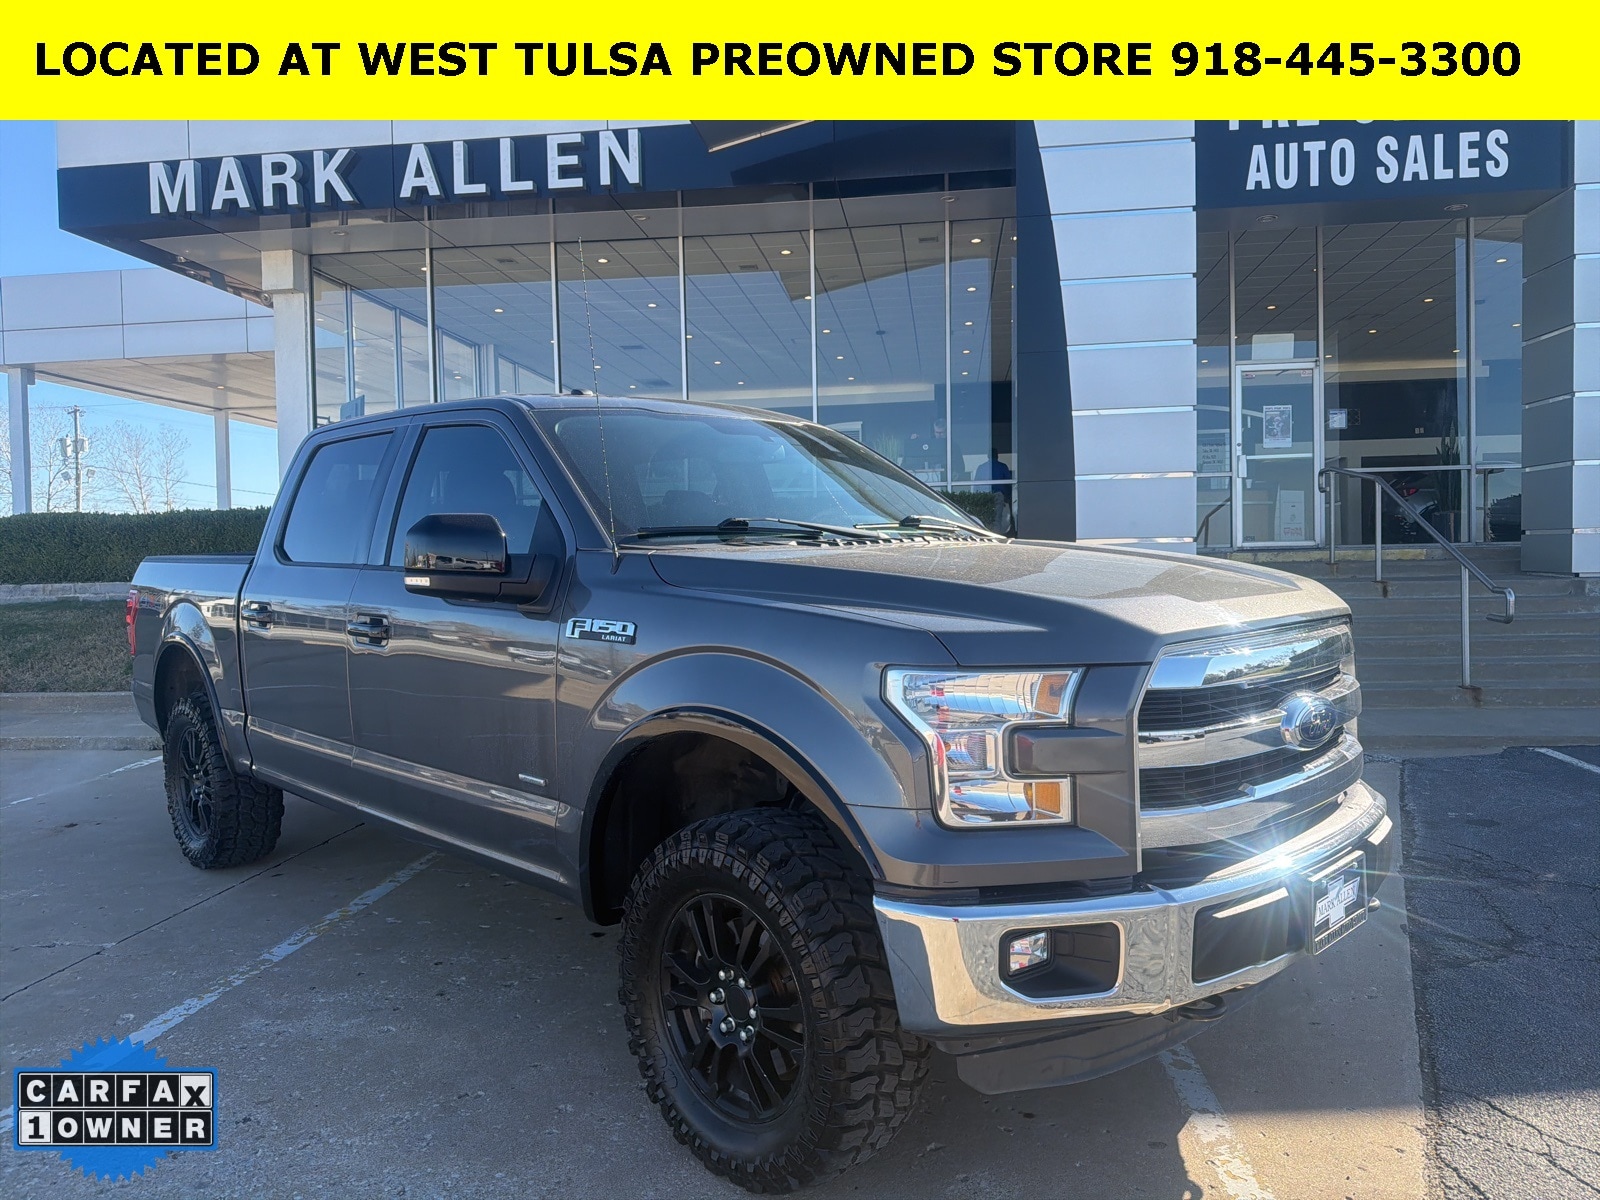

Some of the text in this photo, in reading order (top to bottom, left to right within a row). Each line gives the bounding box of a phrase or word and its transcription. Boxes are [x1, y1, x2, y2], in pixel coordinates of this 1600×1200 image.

[149, 129, 642, 214] MARK ALLEN
[1246, 129, 1509, 190] AUTO SALES
[601, 634, 627, 642] LARIAT
[1318, 885, 1357, 917] MARK ALLEN
